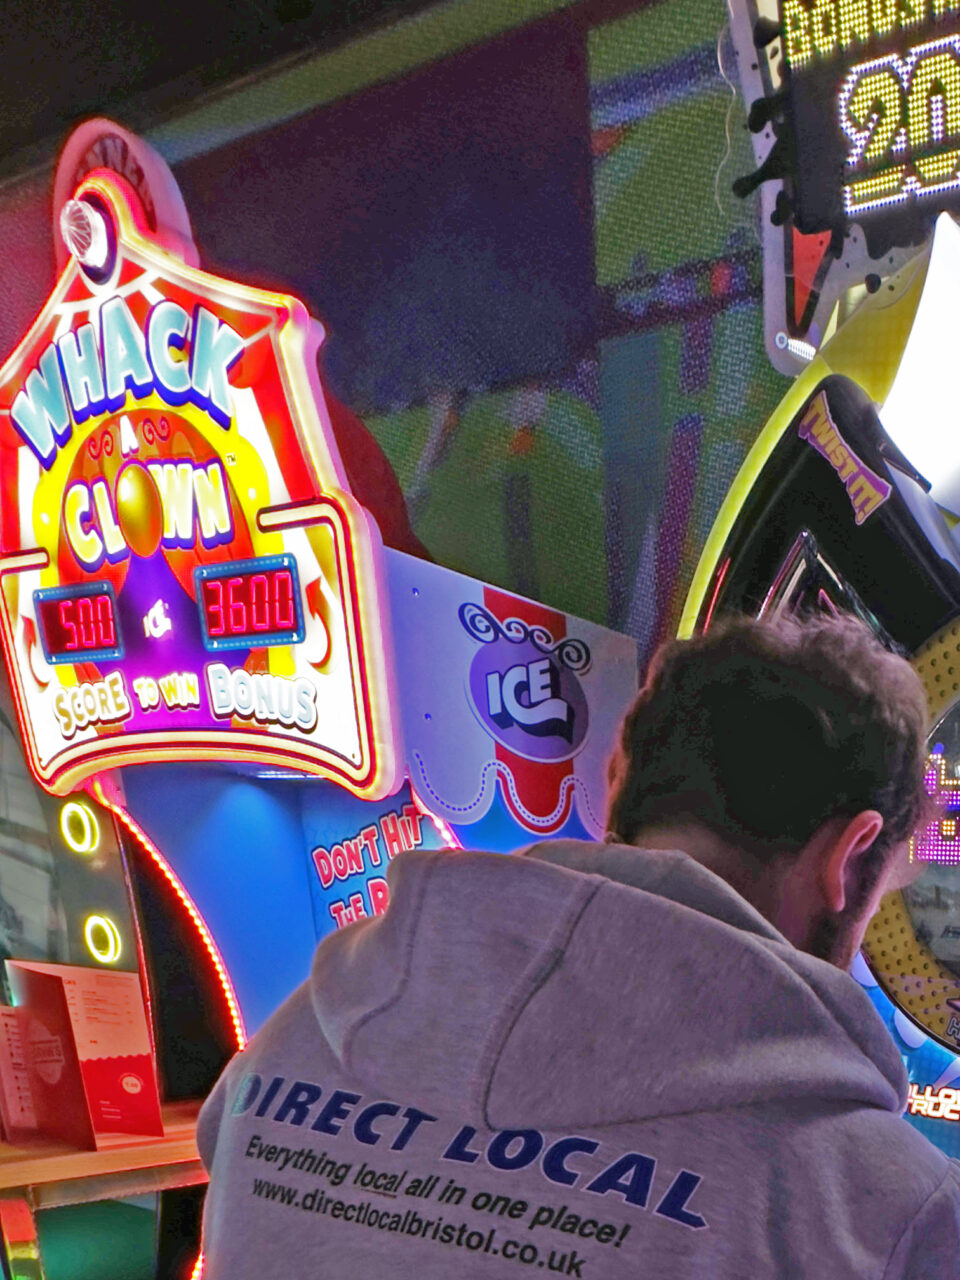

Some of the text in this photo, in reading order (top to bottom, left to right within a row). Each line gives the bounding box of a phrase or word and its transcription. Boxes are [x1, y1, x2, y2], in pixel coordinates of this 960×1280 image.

[10, 295, 245, 471] WHACK
[119, 414, 140, 459] A
[798, 390, 860, 483] TWIST
[59, 595, 116, 650] 500
[206, 571, 295, 636] 3600
[54, 661, 318, 740] SCORE TO WIN BONUS
[486, 657, 574, 744] ICE
[312, 803, 424, 888] DON'T HIT
[233, 1072, 709, 1231] DIRECT LOCAL
[244, 1135, 632, 1249] Everything local all in one place!
[251, 1175, 588, 1280] www.directlocalbristol.co.uk
